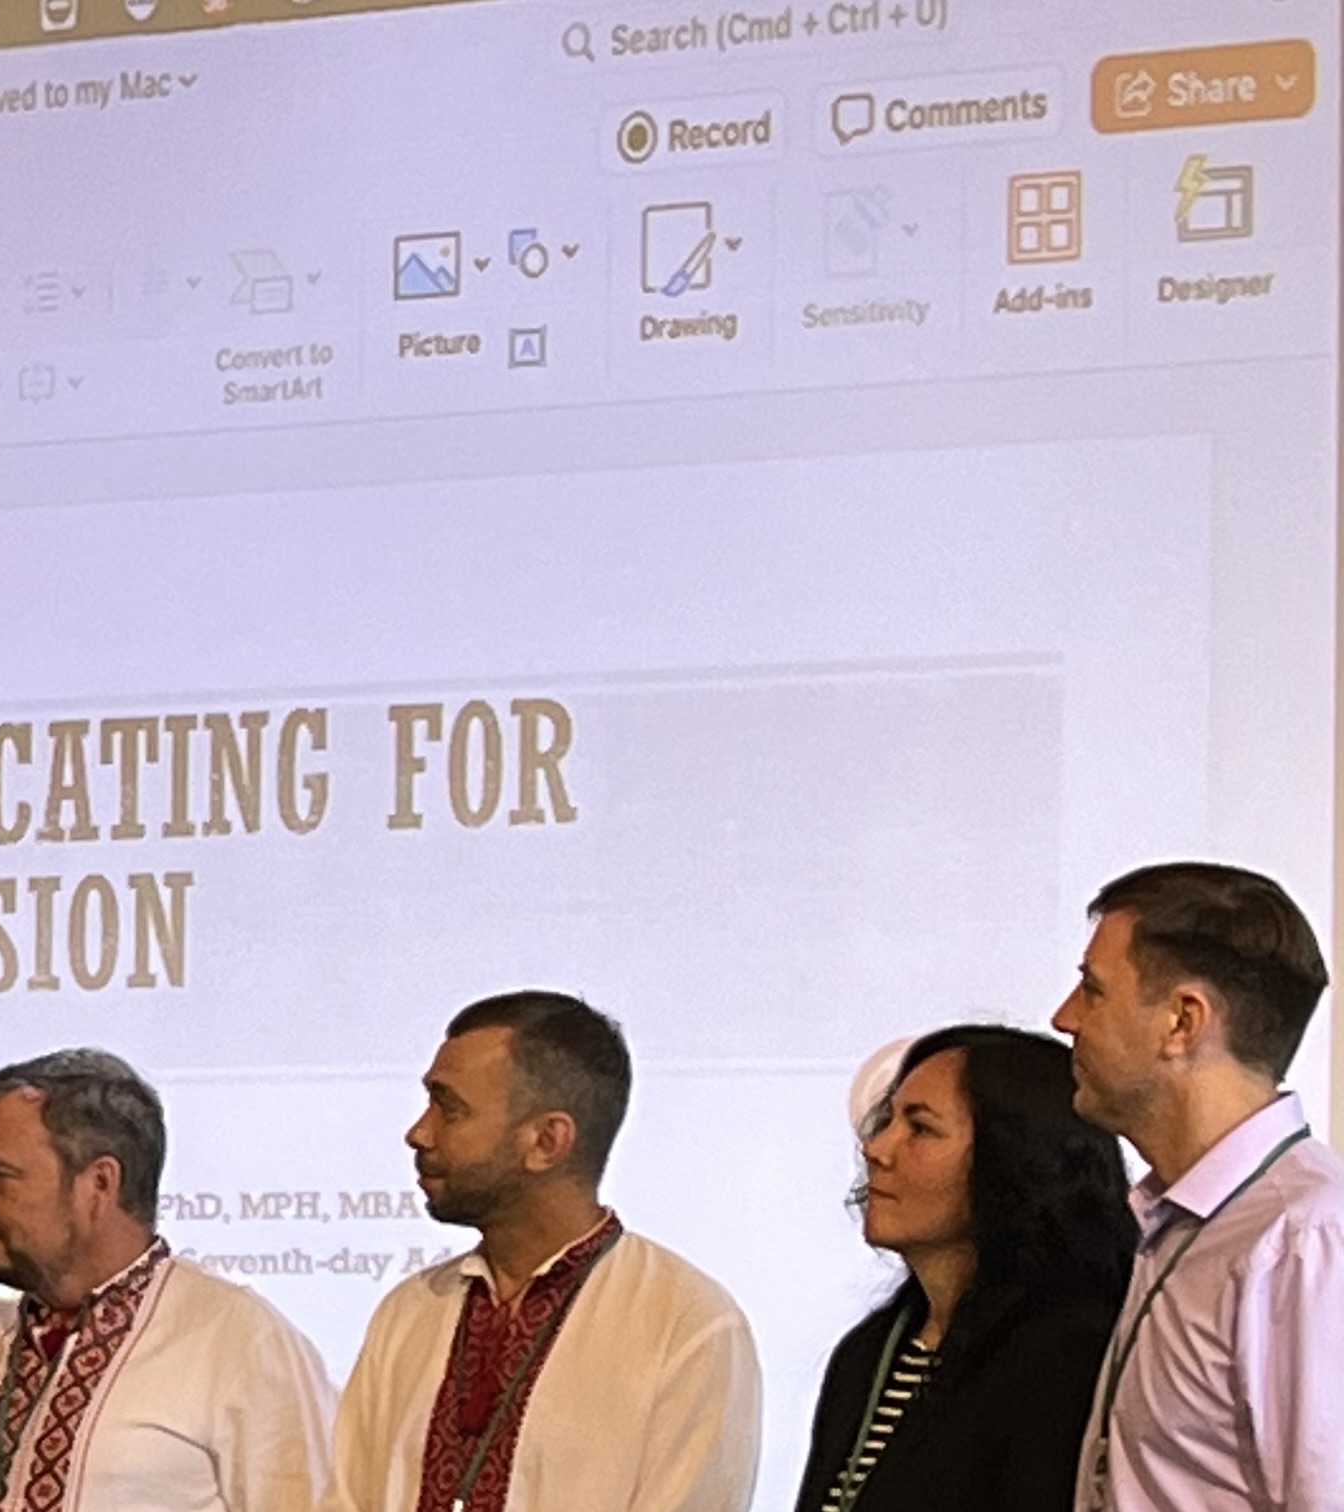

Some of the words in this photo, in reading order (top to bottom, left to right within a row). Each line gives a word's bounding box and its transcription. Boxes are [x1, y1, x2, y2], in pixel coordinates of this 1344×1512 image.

[611, 17, 709, 56] Search
[716, 8, 793, 52] (Cmd
[827, 2, 880, 35] Ctrl
[44, 80, 69, 109] to
[75, 77, 113, 108] my
[120, 70, 172, 101] Mac
[1167, 70, 1257, 107] Share
[885, 90, 1048, 132] Comments
[667, 112, 772, 152] Record
[992, 283, 1094, 315] Add-ins
[1158, 272, 1275, 308] Designer
[639, 311, 739, 342] Drawing
[802, 297, 931, 330] Sensitivity
[215, 345, 303, 374] Convert
[310, 341, 335, 366] to
[398, 331, 482, 359] Picture
[223, 377, 324, 406] SmartArt
[387, 697, 579, 831] FOR
[239, 1191, 331, 1224] MPH,
[338, 1190, 421, 1221] MBA
